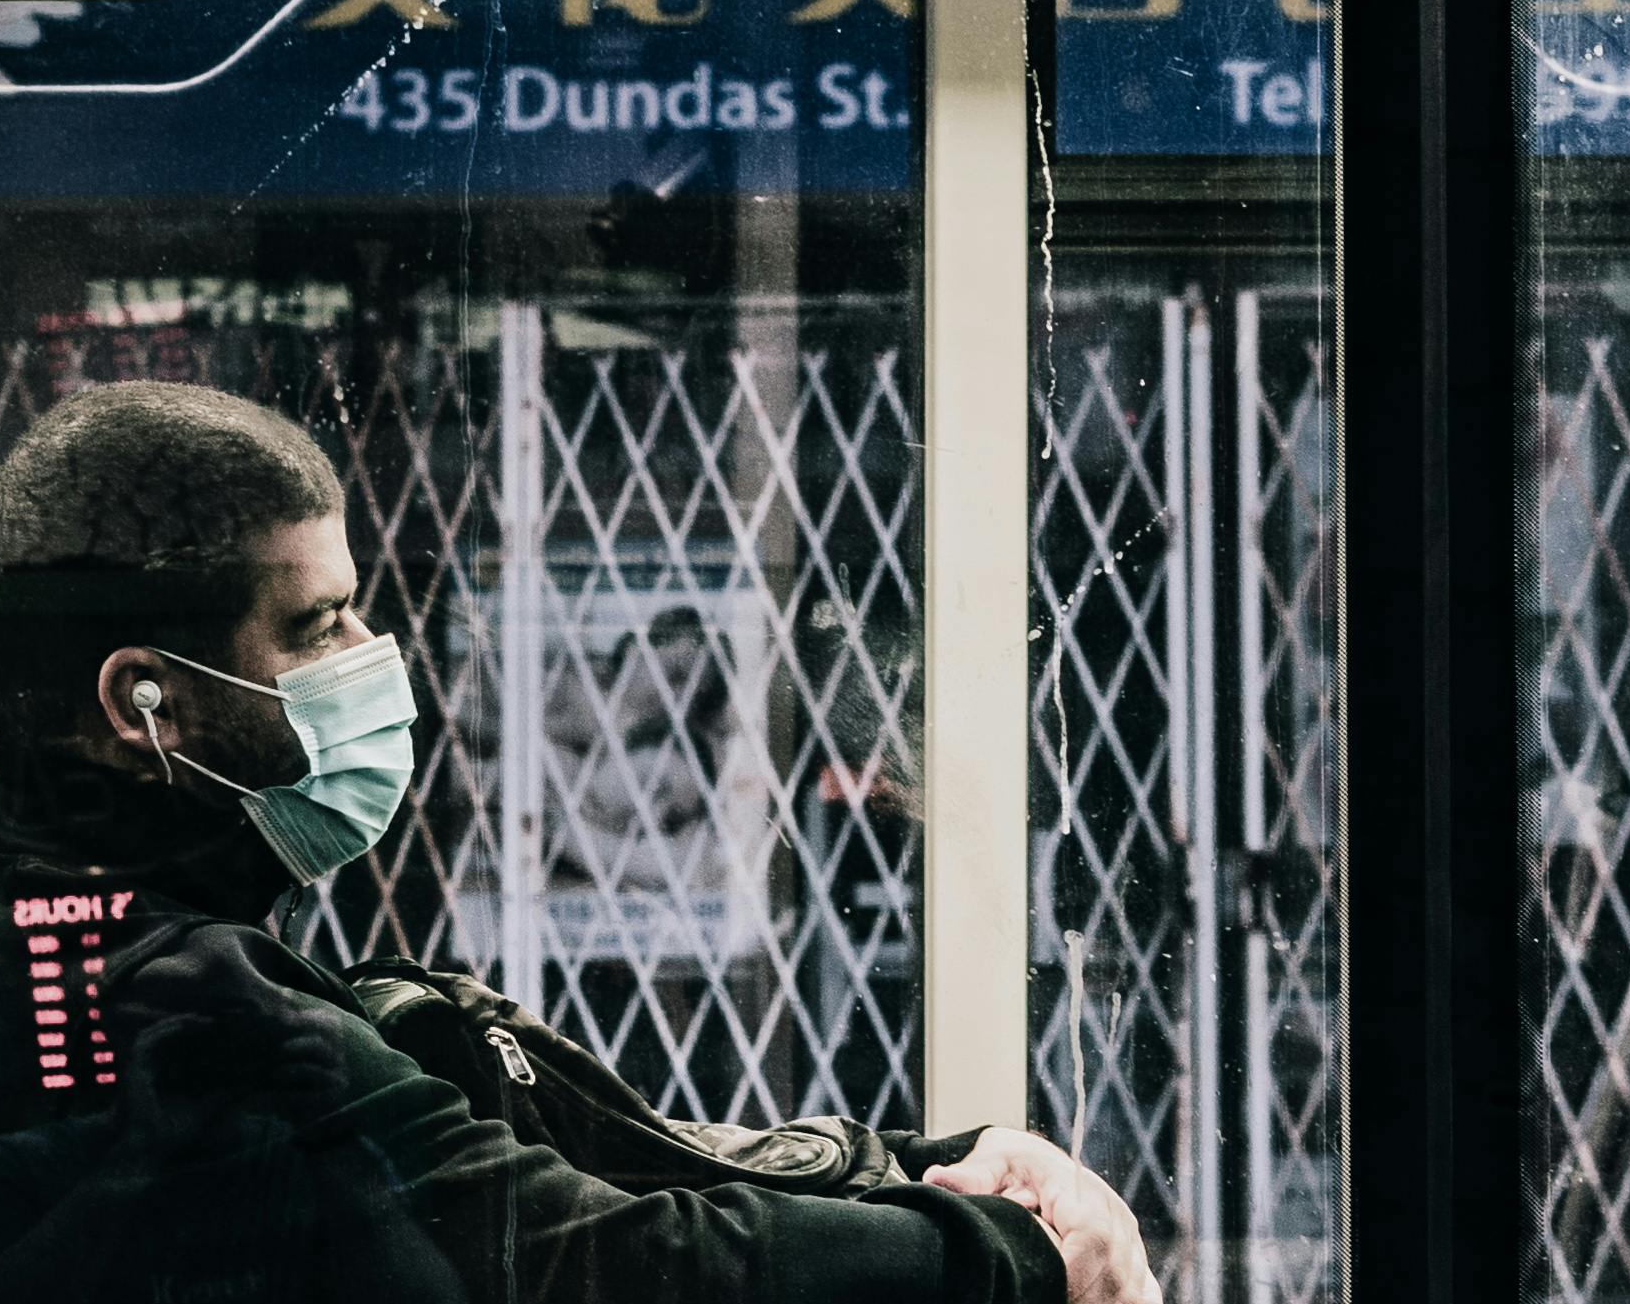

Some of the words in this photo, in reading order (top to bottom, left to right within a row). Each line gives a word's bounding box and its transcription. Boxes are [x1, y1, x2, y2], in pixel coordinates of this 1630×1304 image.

[339, 66, 477, 134] 435
[503, 61, 799, 133] Dundas
[818, 61, 912, 132] St.
